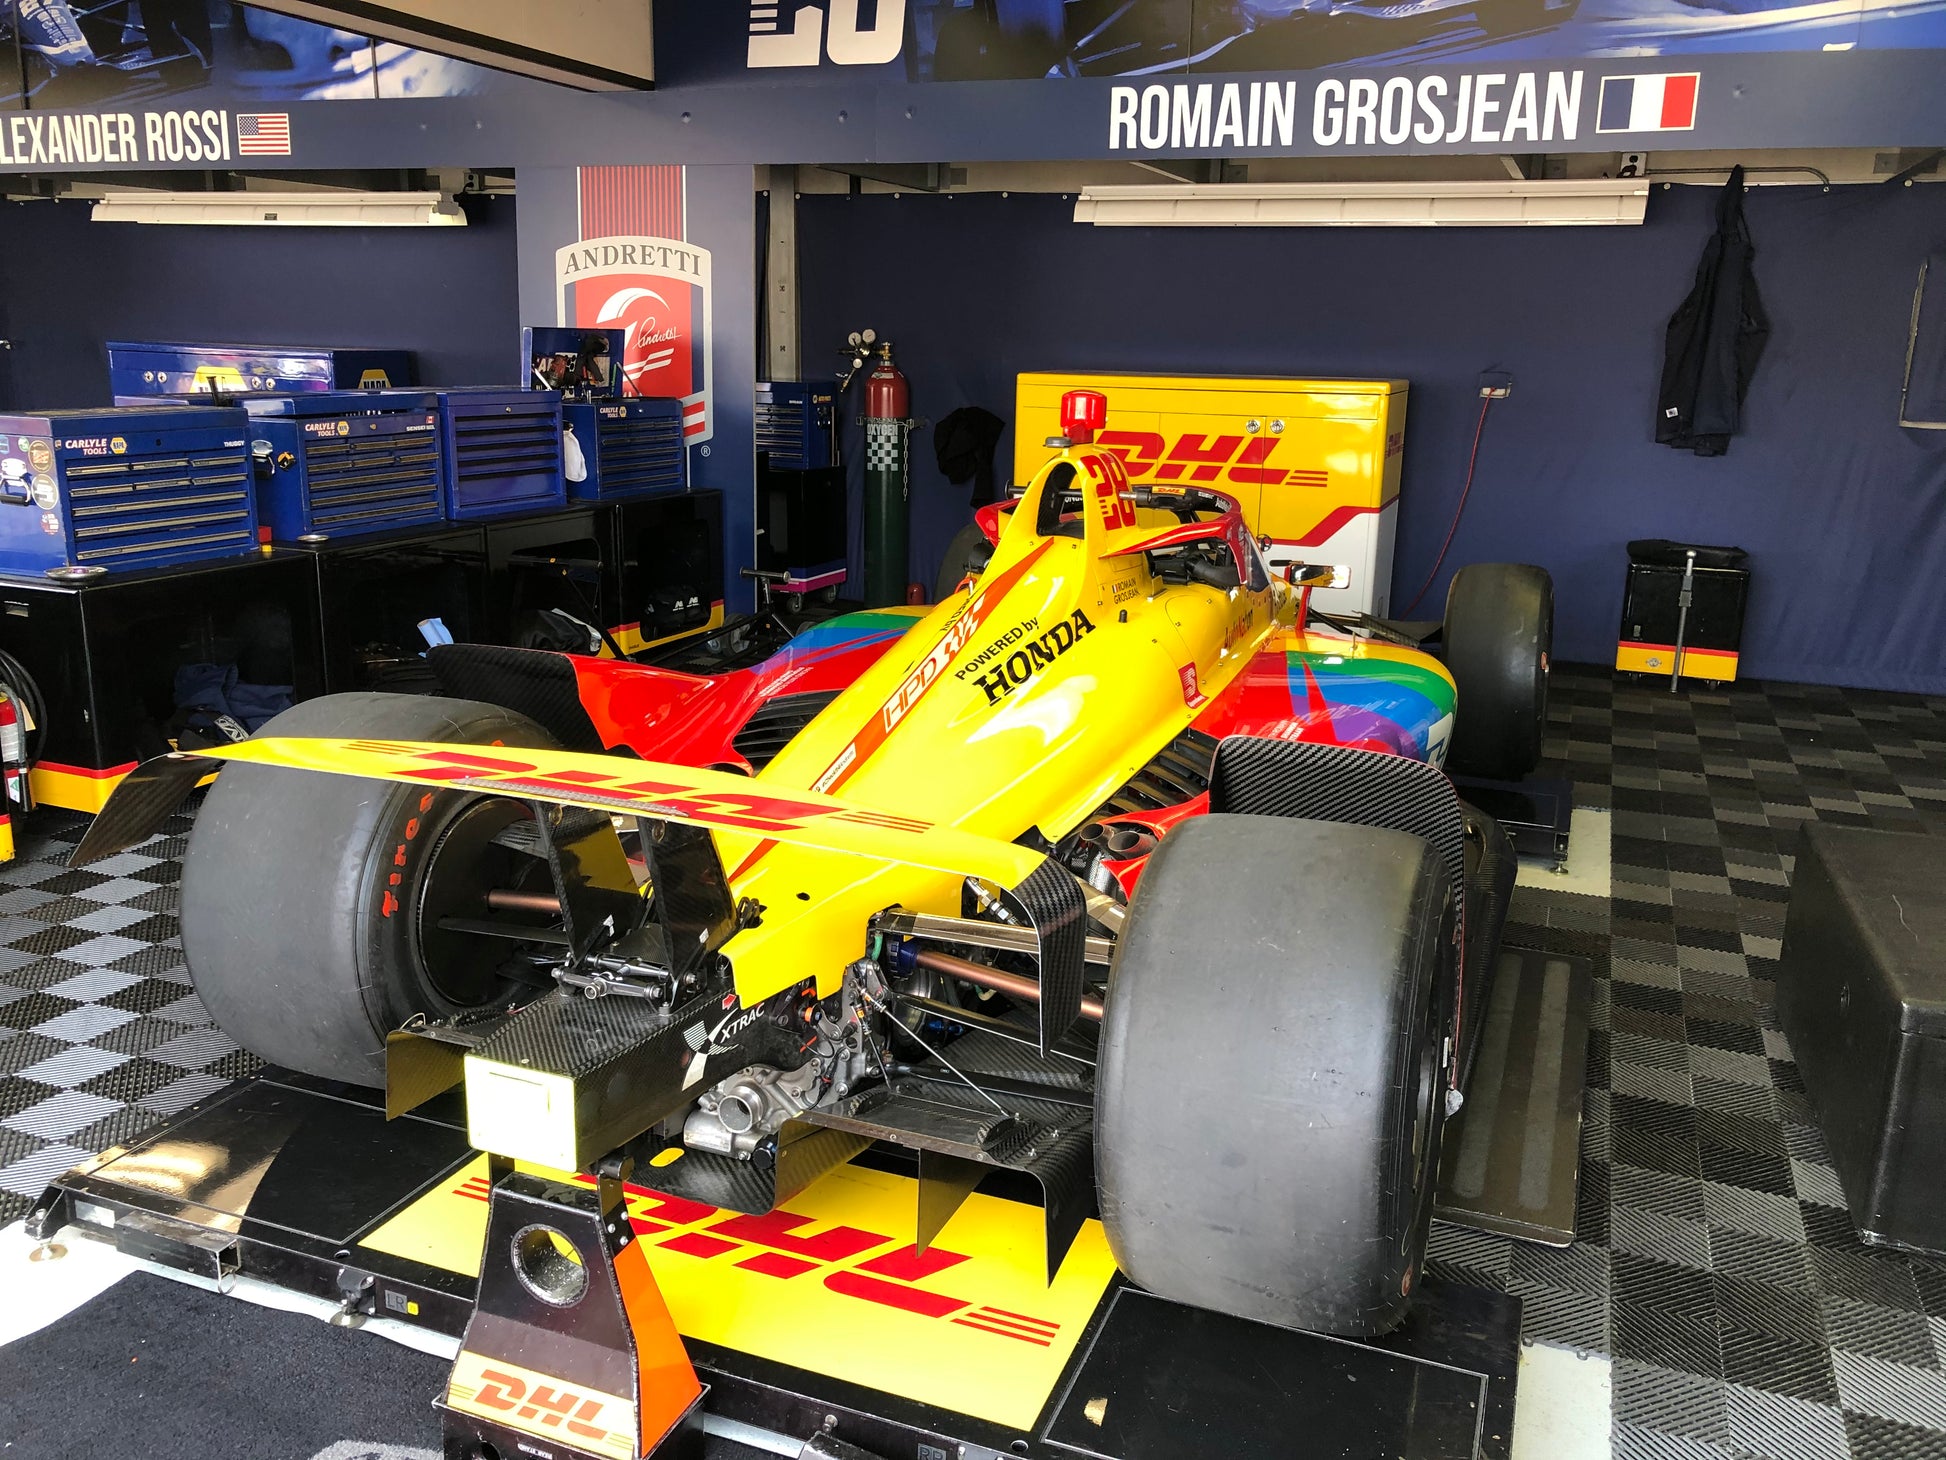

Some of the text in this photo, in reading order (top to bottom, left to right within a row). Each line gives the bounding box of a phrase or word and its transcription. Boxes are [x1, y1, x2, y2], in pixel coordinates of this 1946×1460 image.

[1109, 70, 1584, 149] ROMAIN GROSJEAN
[144, 110, 231, 161] ROSSI
[564, 244, 702, 276] ANDRETTI
[65, 438, 107, 449] CARLYLE
[305, 422, 336, 432] CARLYLE
[867, 423, 898, 436] OXYGEN
[83, 447, 107, 456] TOOLS
[1095, 430, 1290, 485] DHL
[1080, 452, 1137, 531] 28
[1157, 486, 1182, 495] DHL
[1113, 587, 1140, 604] GROSJEAN
[1118, 577, 1137, 593] ROMAIN
[954, 616, 1039, 681] POWERED by
[972, 608, 1096, 707] HONDA
[885, 656, 937, 729] HPD
[386, 751, 847, 831] DHL
[720, 1002, 765, 1043] XTRAC
[572, 1174, 974, 1318] DHL
[387, 1293, 406, 1312] LR
[474, 1369, 608, 1440] DHL
